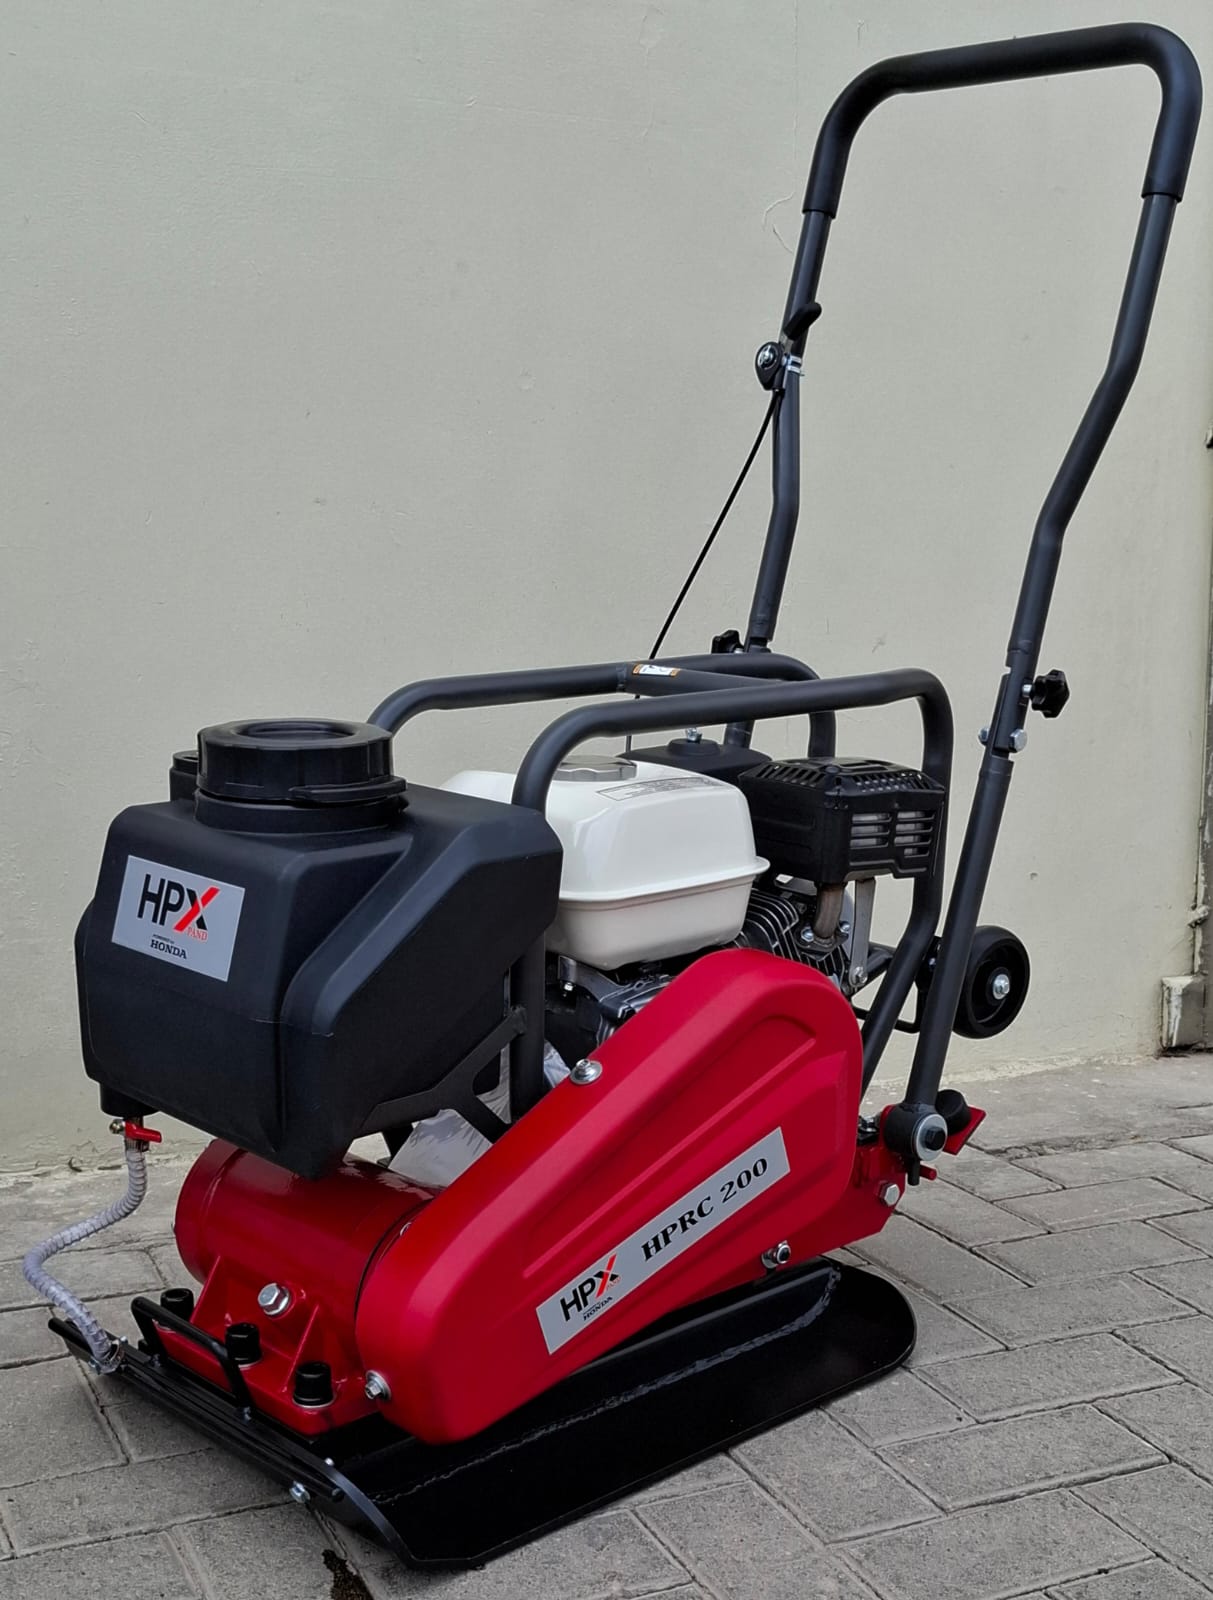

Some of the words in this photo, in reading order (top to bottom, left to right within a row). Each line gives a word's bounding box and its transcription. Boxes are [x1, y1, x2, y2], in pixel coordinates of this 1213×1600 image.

[137, 873, 220, 933] HPX
[150, 939, 187, 959] HONDA
[641, 1196, 714, 1262] HPRC
[720, 1158, 768, 1204] 200
[560, 1253, 619, 1322] HPX
